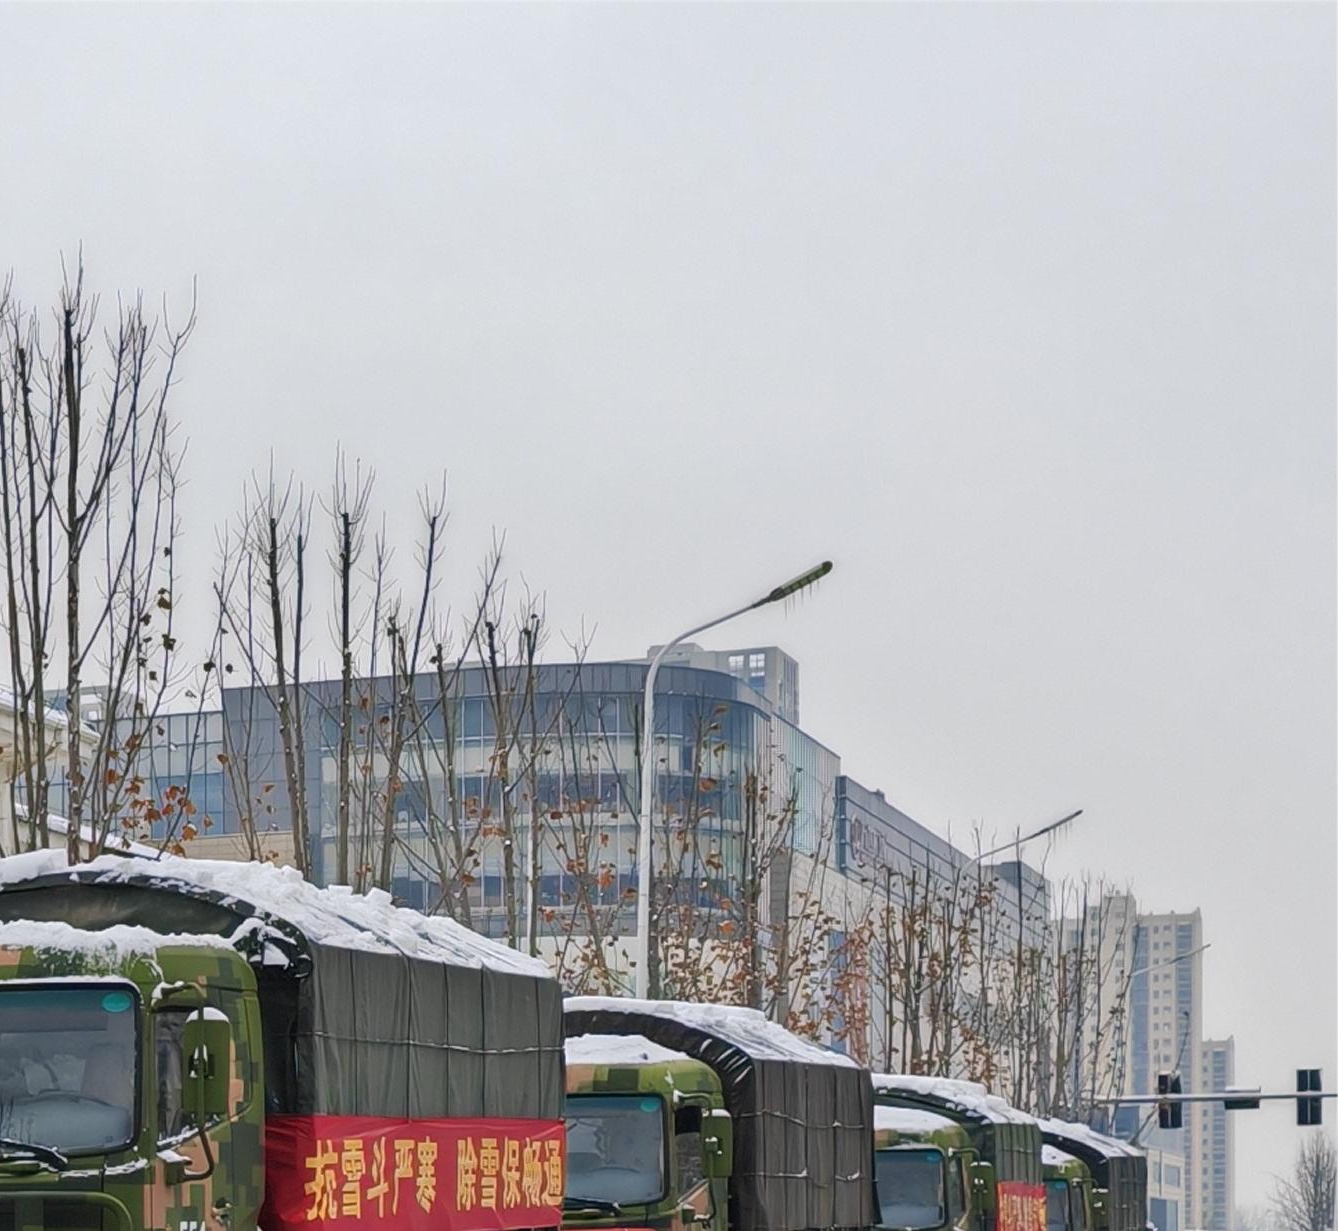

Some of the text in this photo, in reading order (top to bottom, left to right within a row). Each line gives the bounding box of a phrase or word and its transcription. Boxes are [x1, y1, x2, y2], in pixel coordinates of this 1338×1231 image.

[304, 1136, 563, 1220] 抗雪斗严寒 除雪保畅通
